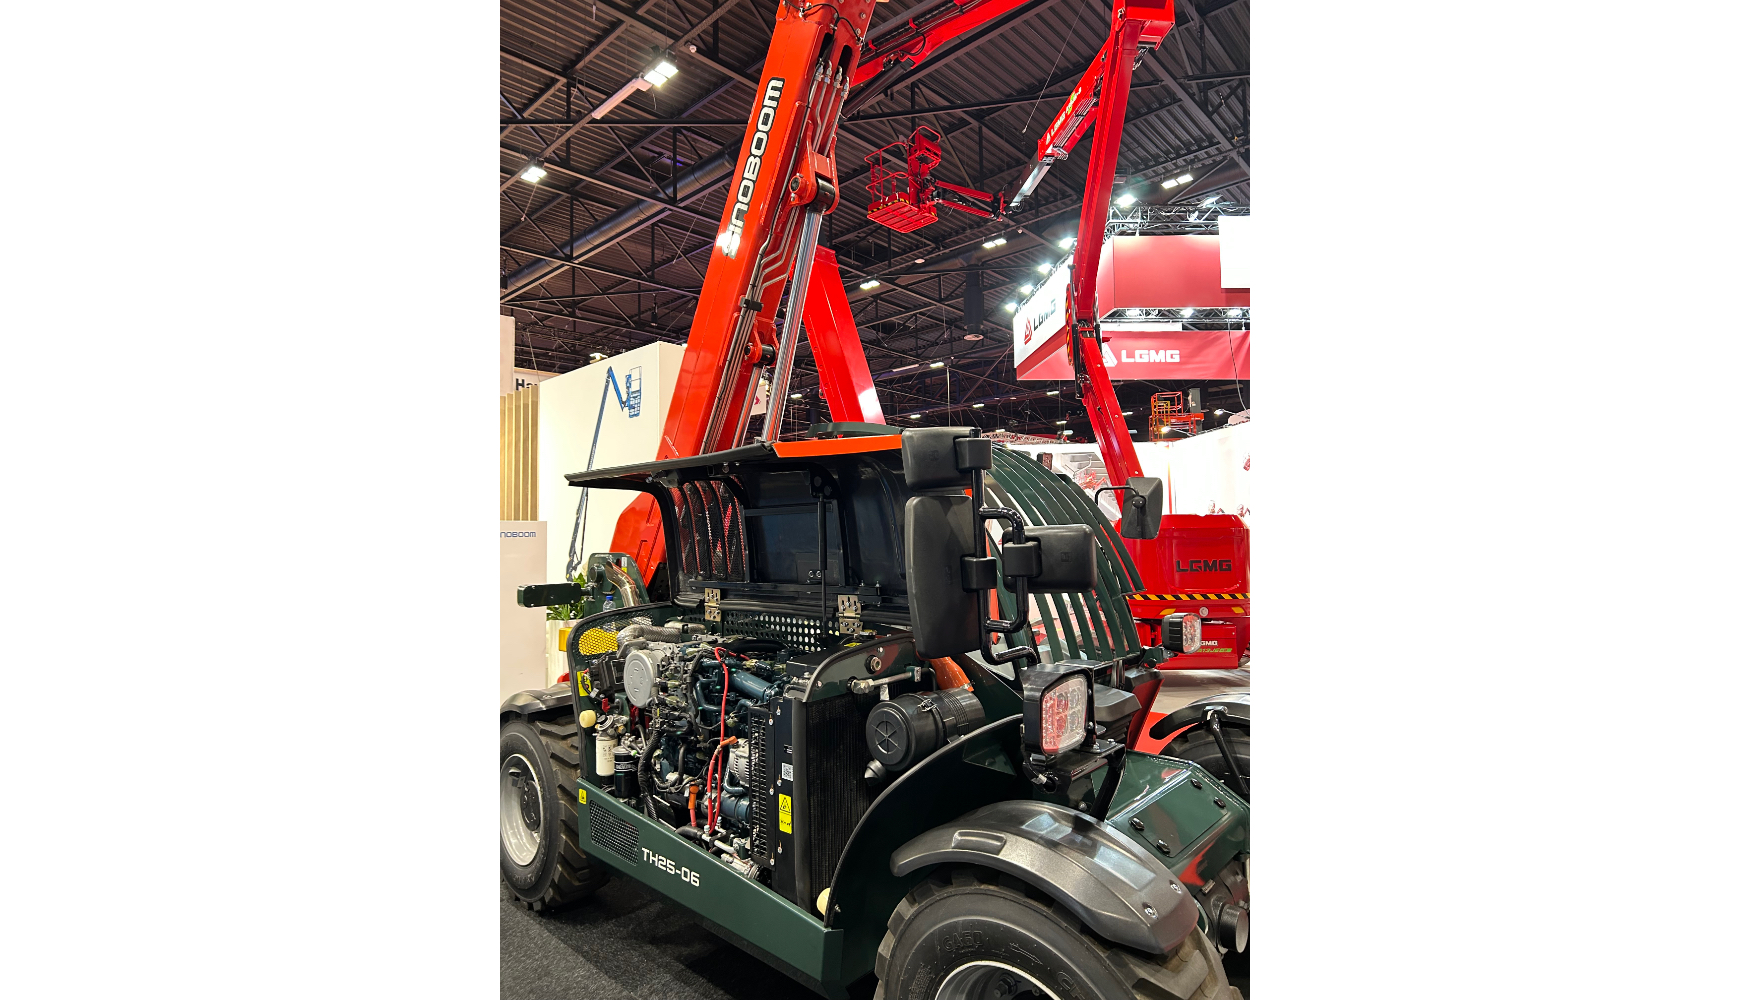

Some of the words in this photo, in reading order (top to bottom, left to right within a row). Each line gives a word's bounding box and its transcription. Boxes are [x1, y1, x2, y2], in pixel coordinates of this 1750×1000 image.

[1121, 350, 1180, 363] LGMG
[1176, 559, 1232, 572] LGMG
[641, 847, 700, 887] TH25-06
